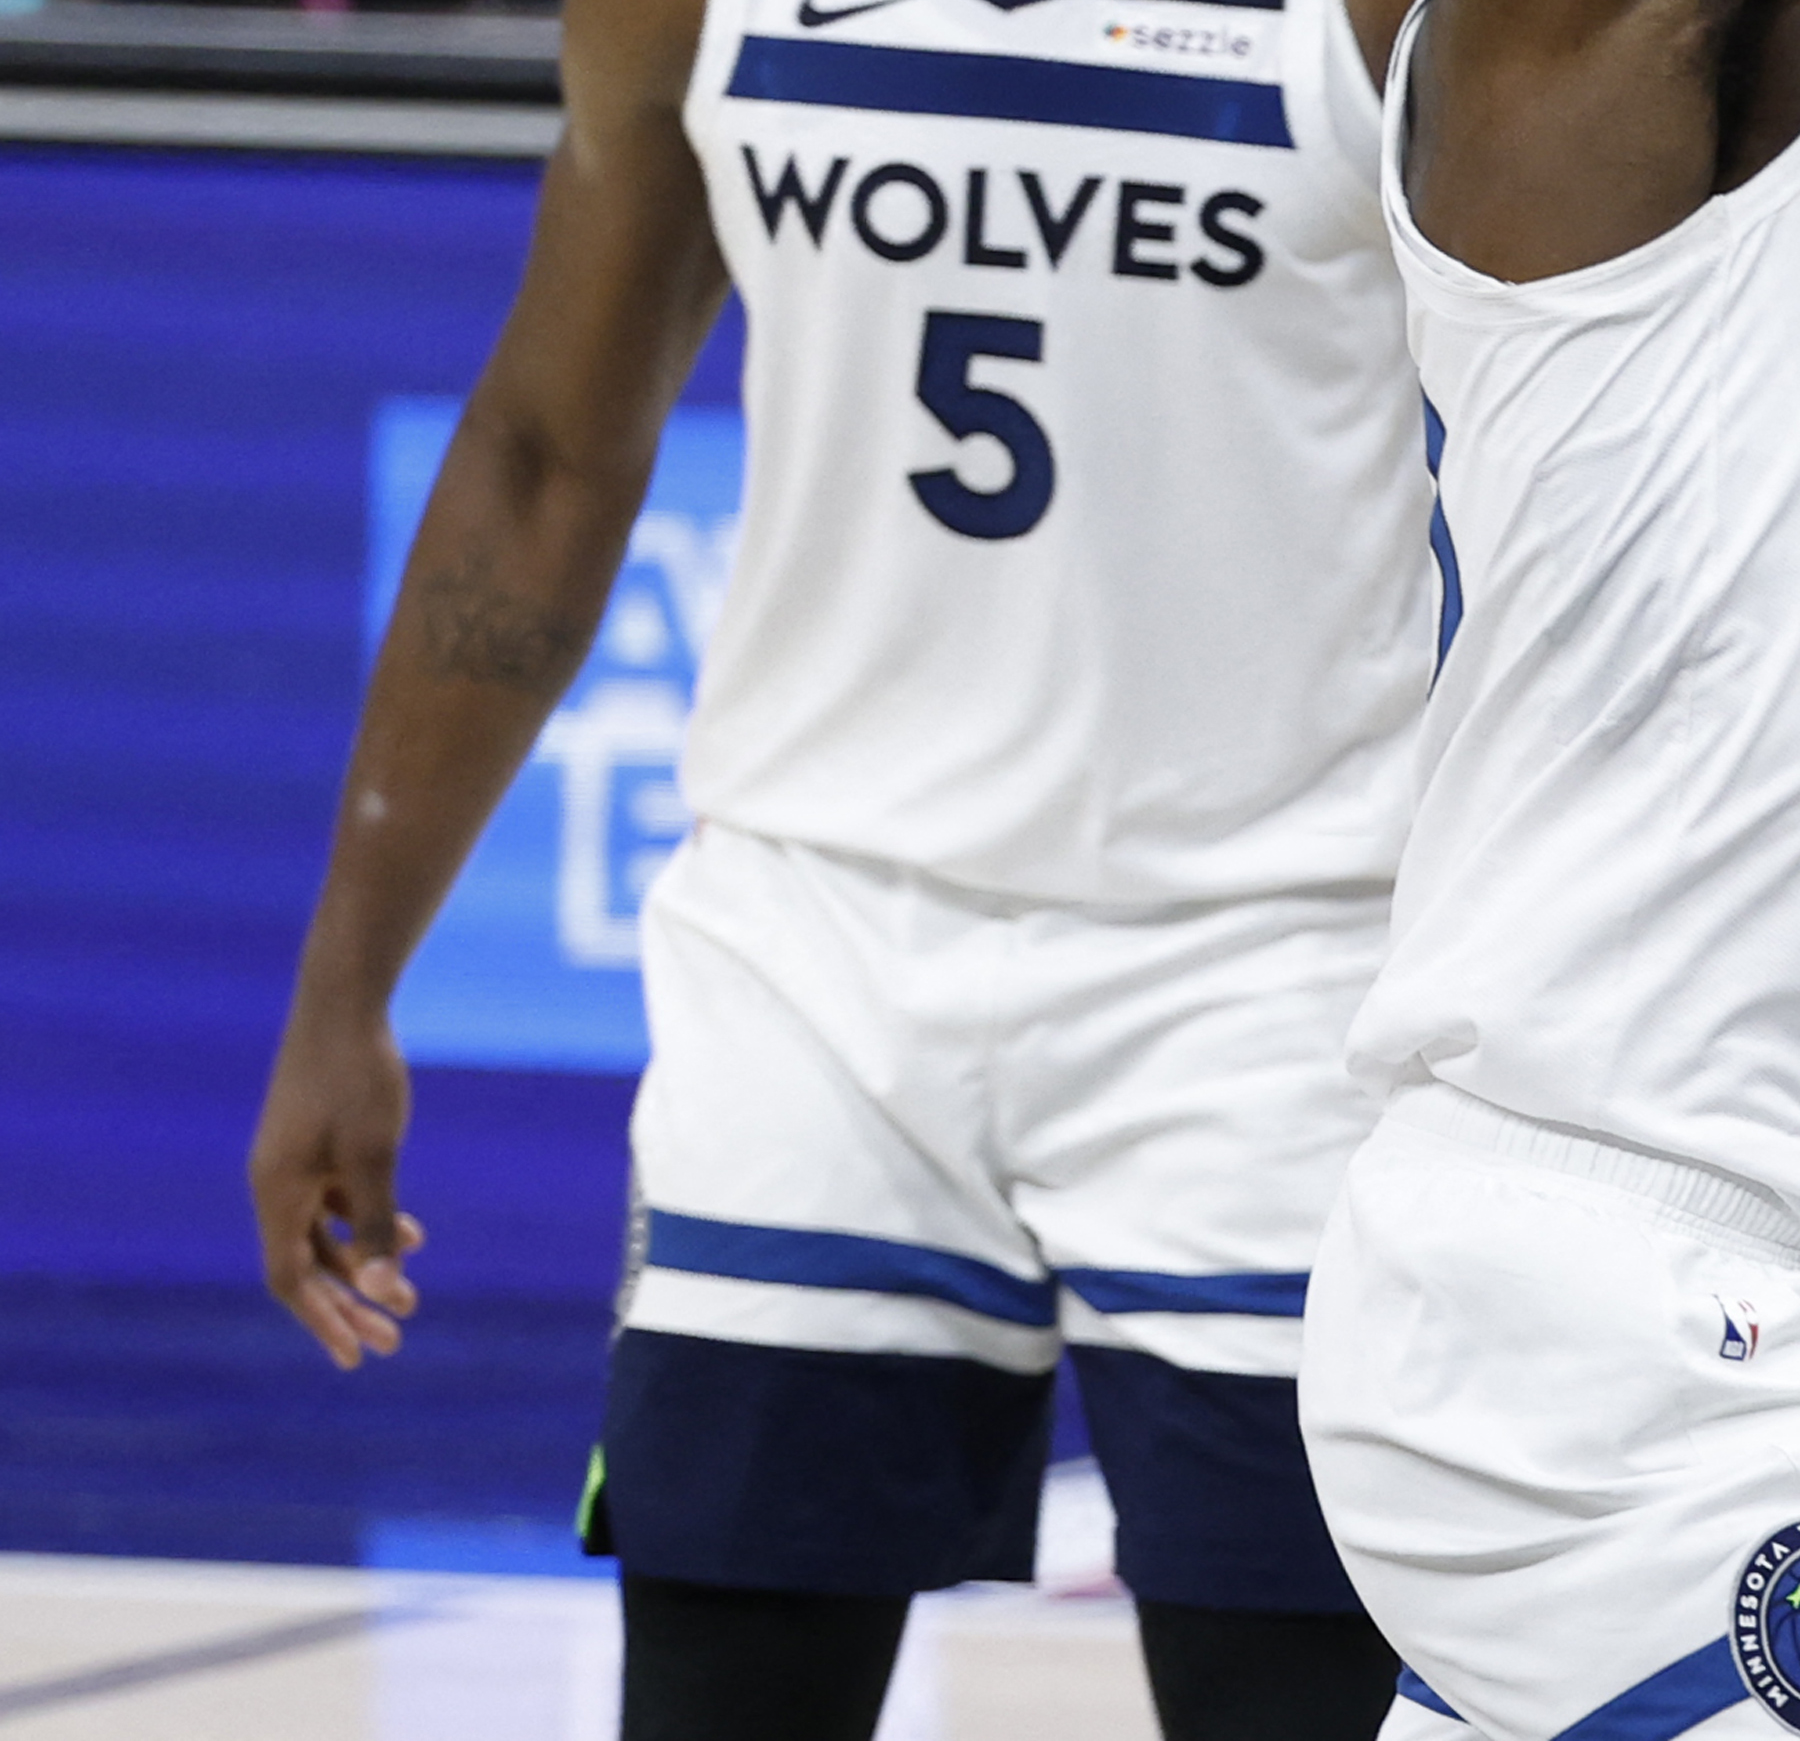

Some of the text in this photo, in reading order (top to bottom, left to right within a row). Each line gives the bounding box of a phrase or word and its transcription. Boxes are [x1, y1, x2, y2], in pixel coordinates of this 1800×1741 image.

[1129, 19, 1254, 58] sezzle
[741, 143, 1266, 287] WOLVES
[907, 308, 1056, 540] 5
[1738, 1539, 1791, 1710] MINNESOTA
